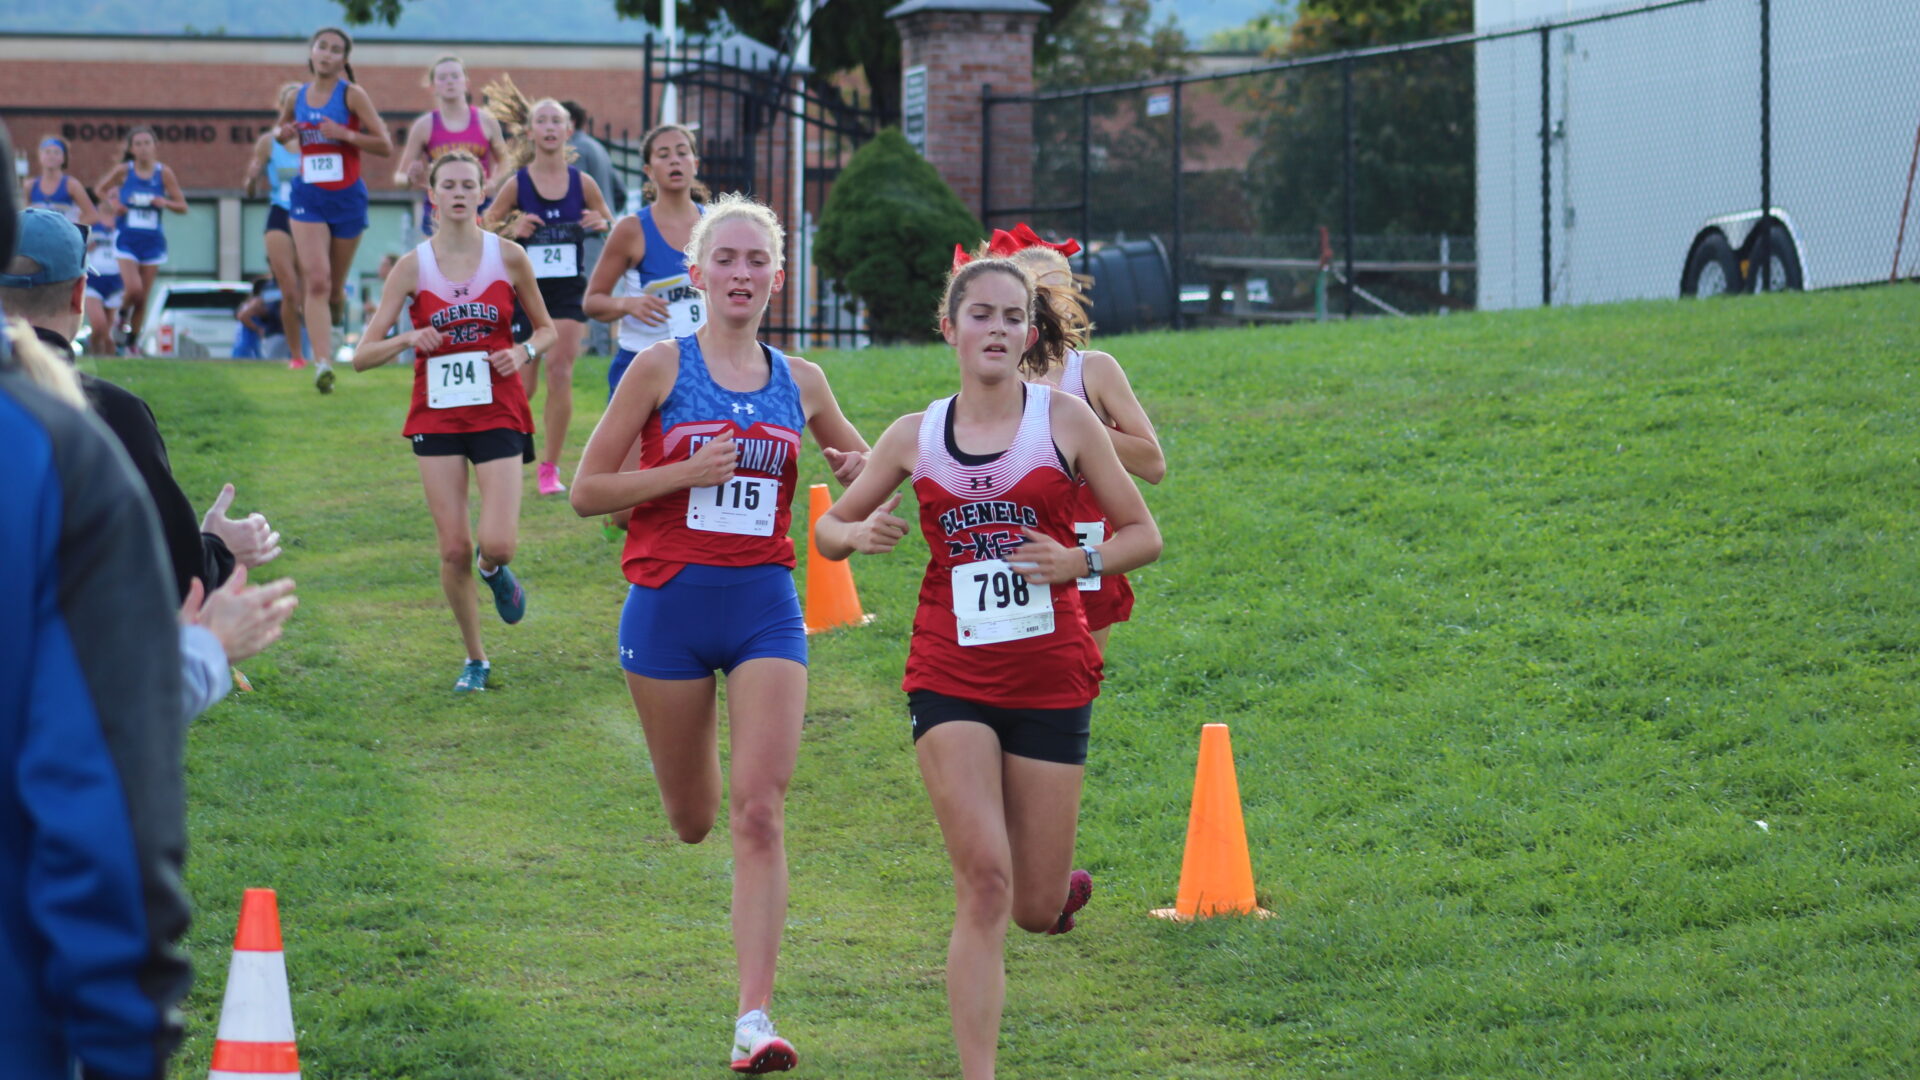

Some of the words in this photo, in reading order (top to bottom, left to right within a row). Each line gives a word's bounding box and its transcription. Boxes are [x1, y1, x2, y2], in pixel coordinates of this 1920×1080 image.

[311, 157, 333, 170] 123
[543, 248, 561, 264] 24
[431, 304, 498, 329] GLENELG
[690, 304, 700, 323] 9
[450, 323, 478, 344] XC
[441, 360, 476, 387] 794
[715, 481, 761, 510] 115
[939, 501, 1038, 536] GLENELG
[970, 531, 1013, 560] XC
[973, 572, 1030, 612] 798
